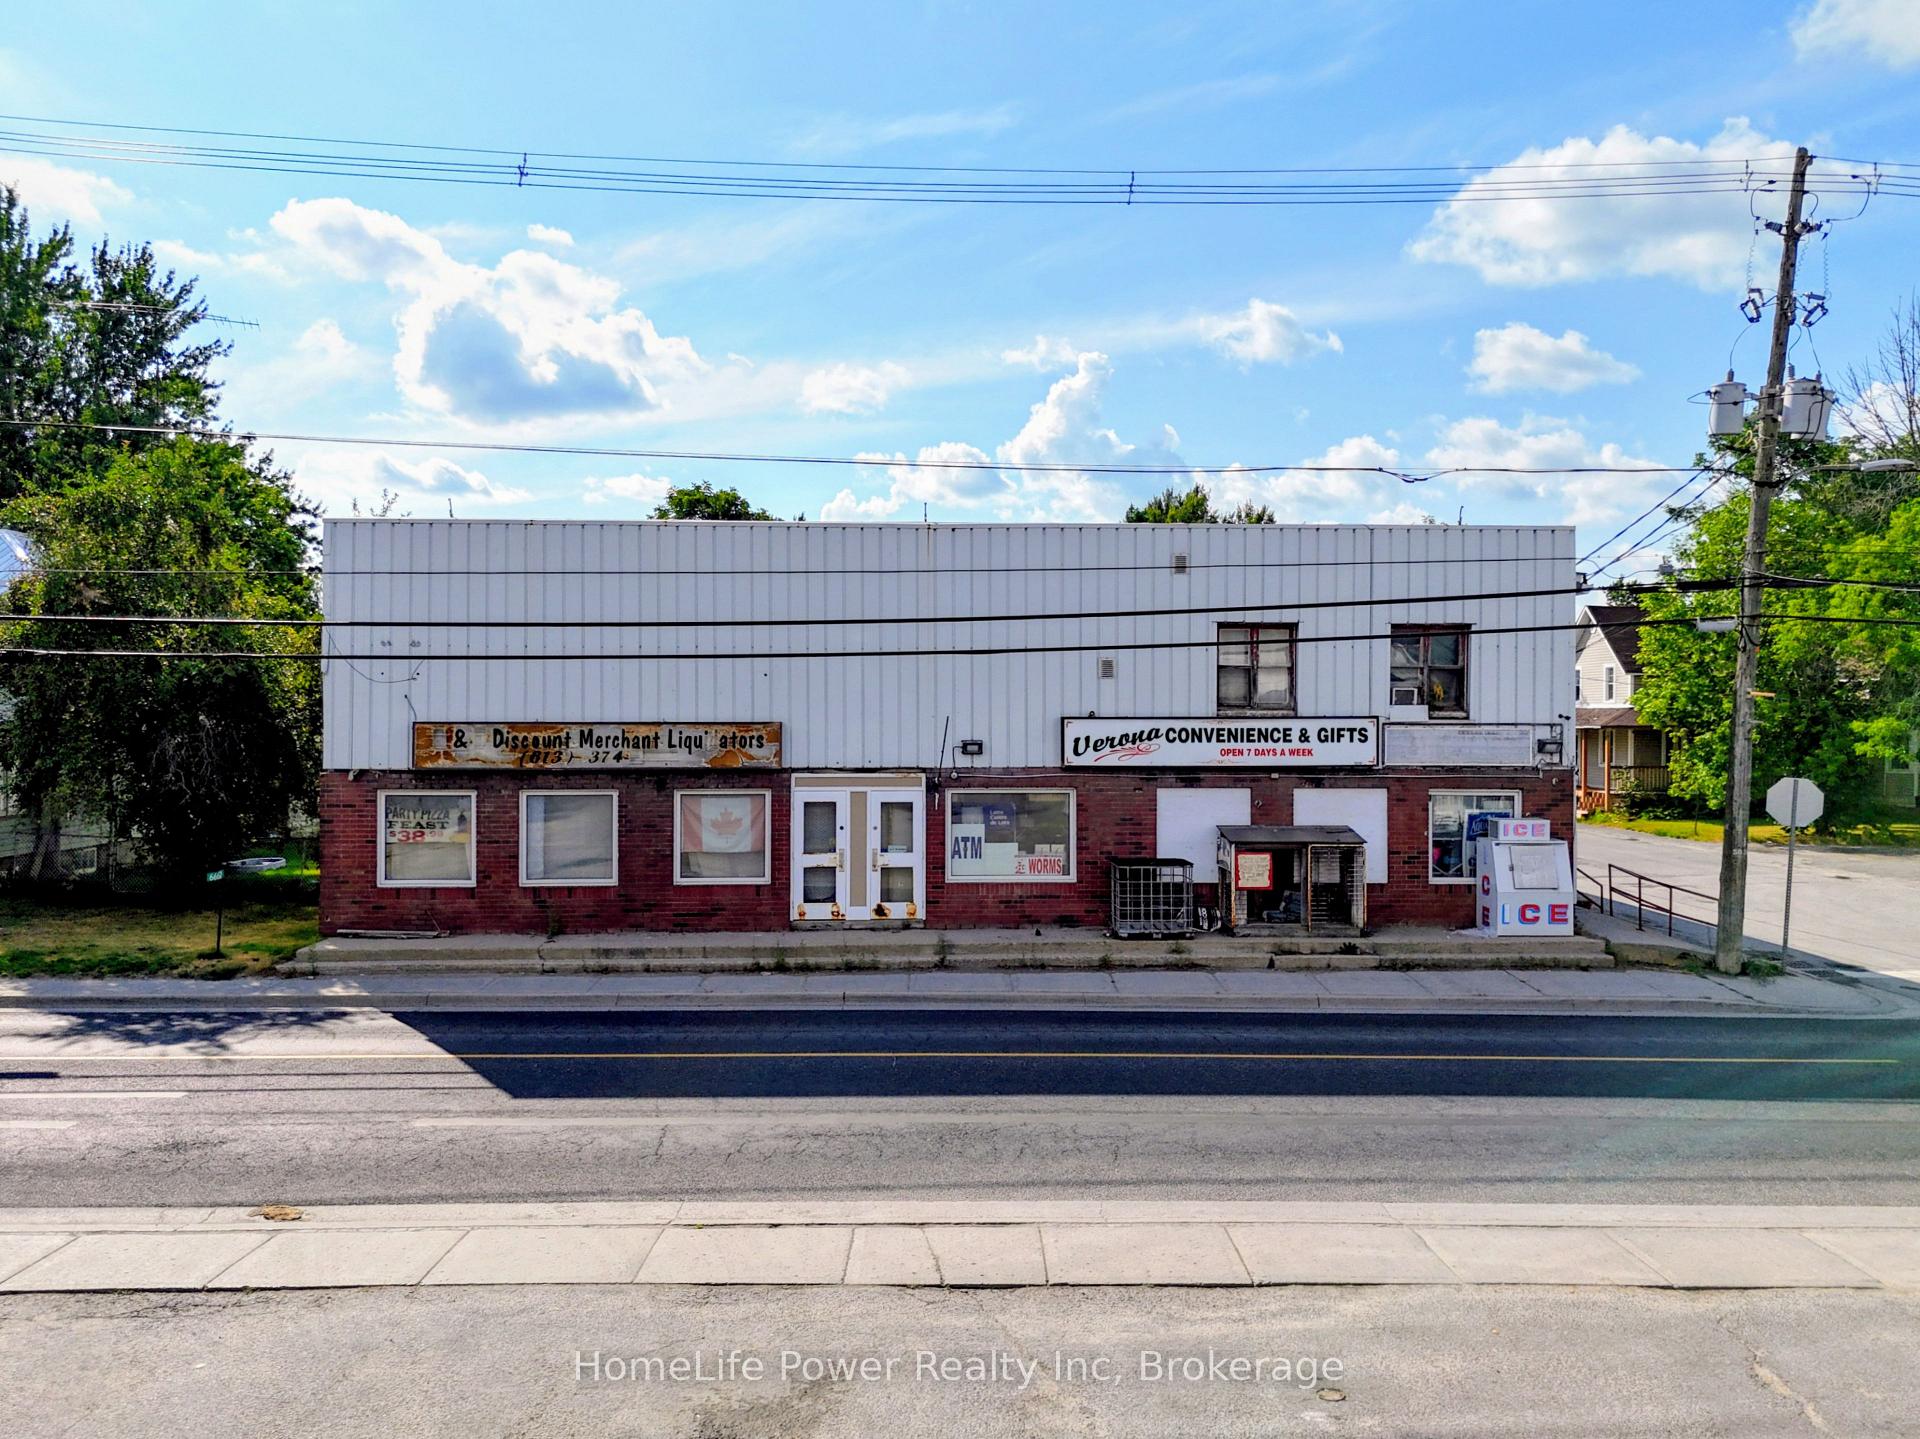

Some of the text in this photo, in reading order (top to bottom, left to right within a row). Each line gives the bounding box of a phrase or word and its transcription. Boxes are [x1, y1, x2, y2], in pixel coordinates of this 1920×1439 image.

[493, 728, 572, 749] Discount
[579, 728, 660, 749] Merchant
[667, 728, 765, 755] Liquators
[1072, 727, 1369, 757] Verona CONVENIENCE & GIFTS
[1220, 748, 1314, 757] OPEN 7 DAYS A WEEK
[385, 806, 450, 820] PARTY PIZZA
[387, 820, 449, 830] FEAST
[1503, 823, 1546, 838] ICE
[951, 836, 982, 859] ATM
[1028, 858, 1062, 875] WORMS
[1502, 903, 1569, 925] ICE
